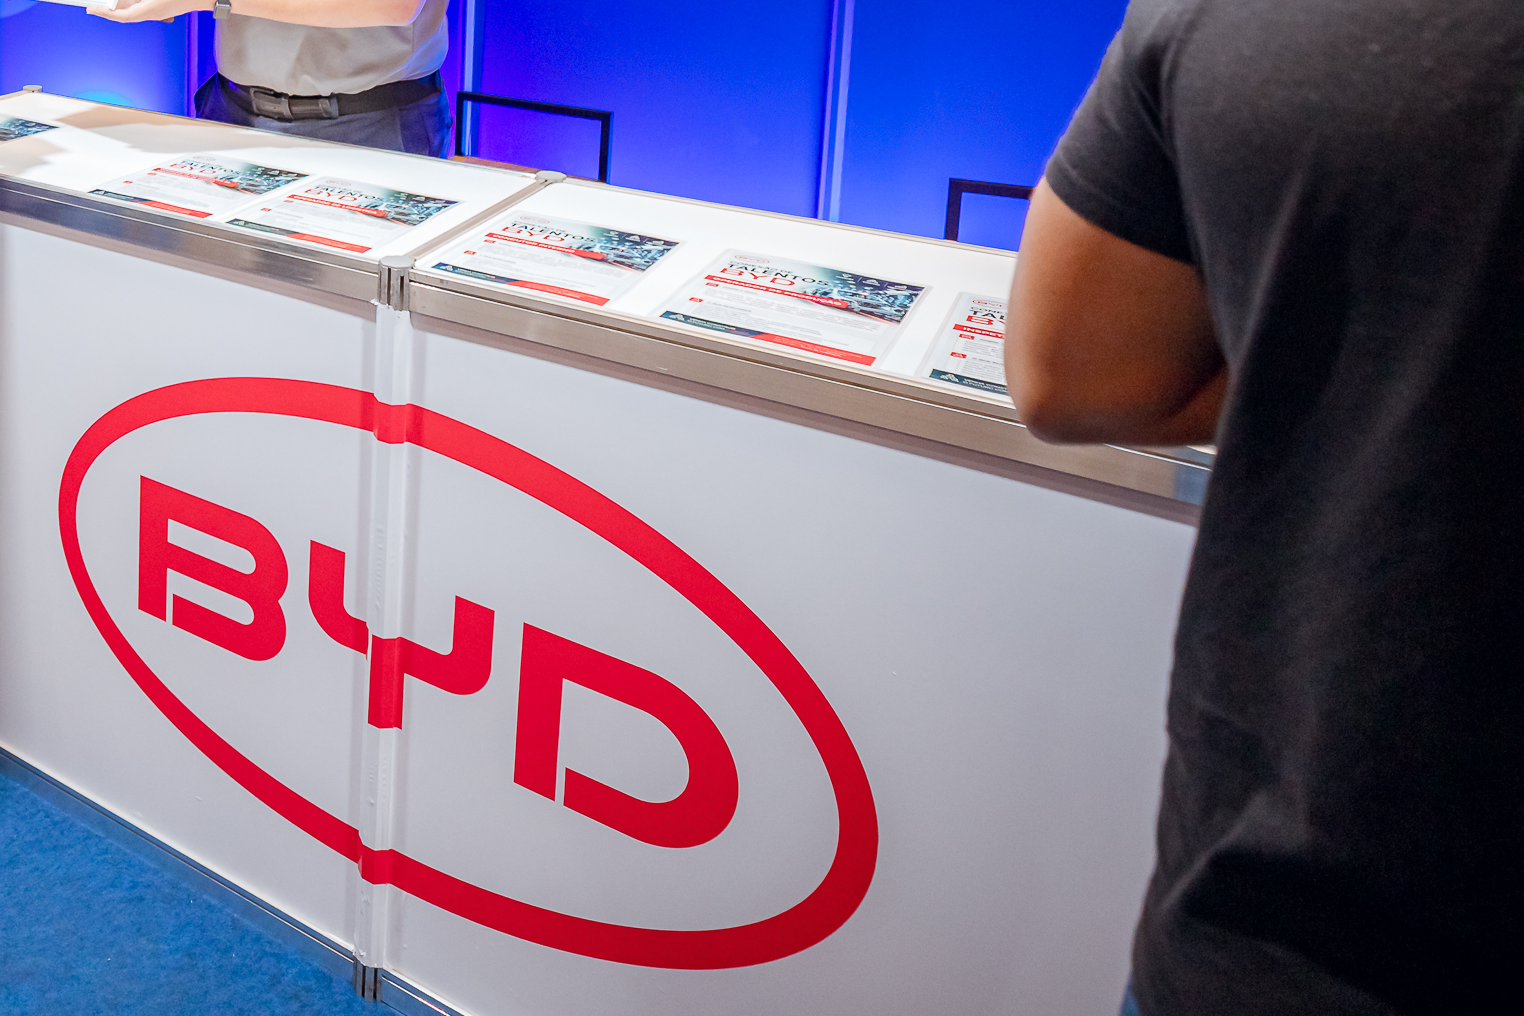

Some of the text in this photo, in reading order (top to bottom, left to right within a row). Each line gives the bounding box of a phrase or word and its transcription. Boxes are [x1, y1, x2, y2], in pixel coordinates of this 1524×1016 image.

[304, 189, 357, 202] BYD
[502, 227, 564, 242] BYD
[512, 223, 596, 242] TALENTOS
[720, 267, 796, 286] BYD
[728, 263, 829, 286] TALENTOS
[711, 277, 767, 291] OPERADOR
[783, 291, 843, 306] PRODUÇÃO
[963, 327, 1005, 338] INSPET
[137, 474, 739, 849] BYD
